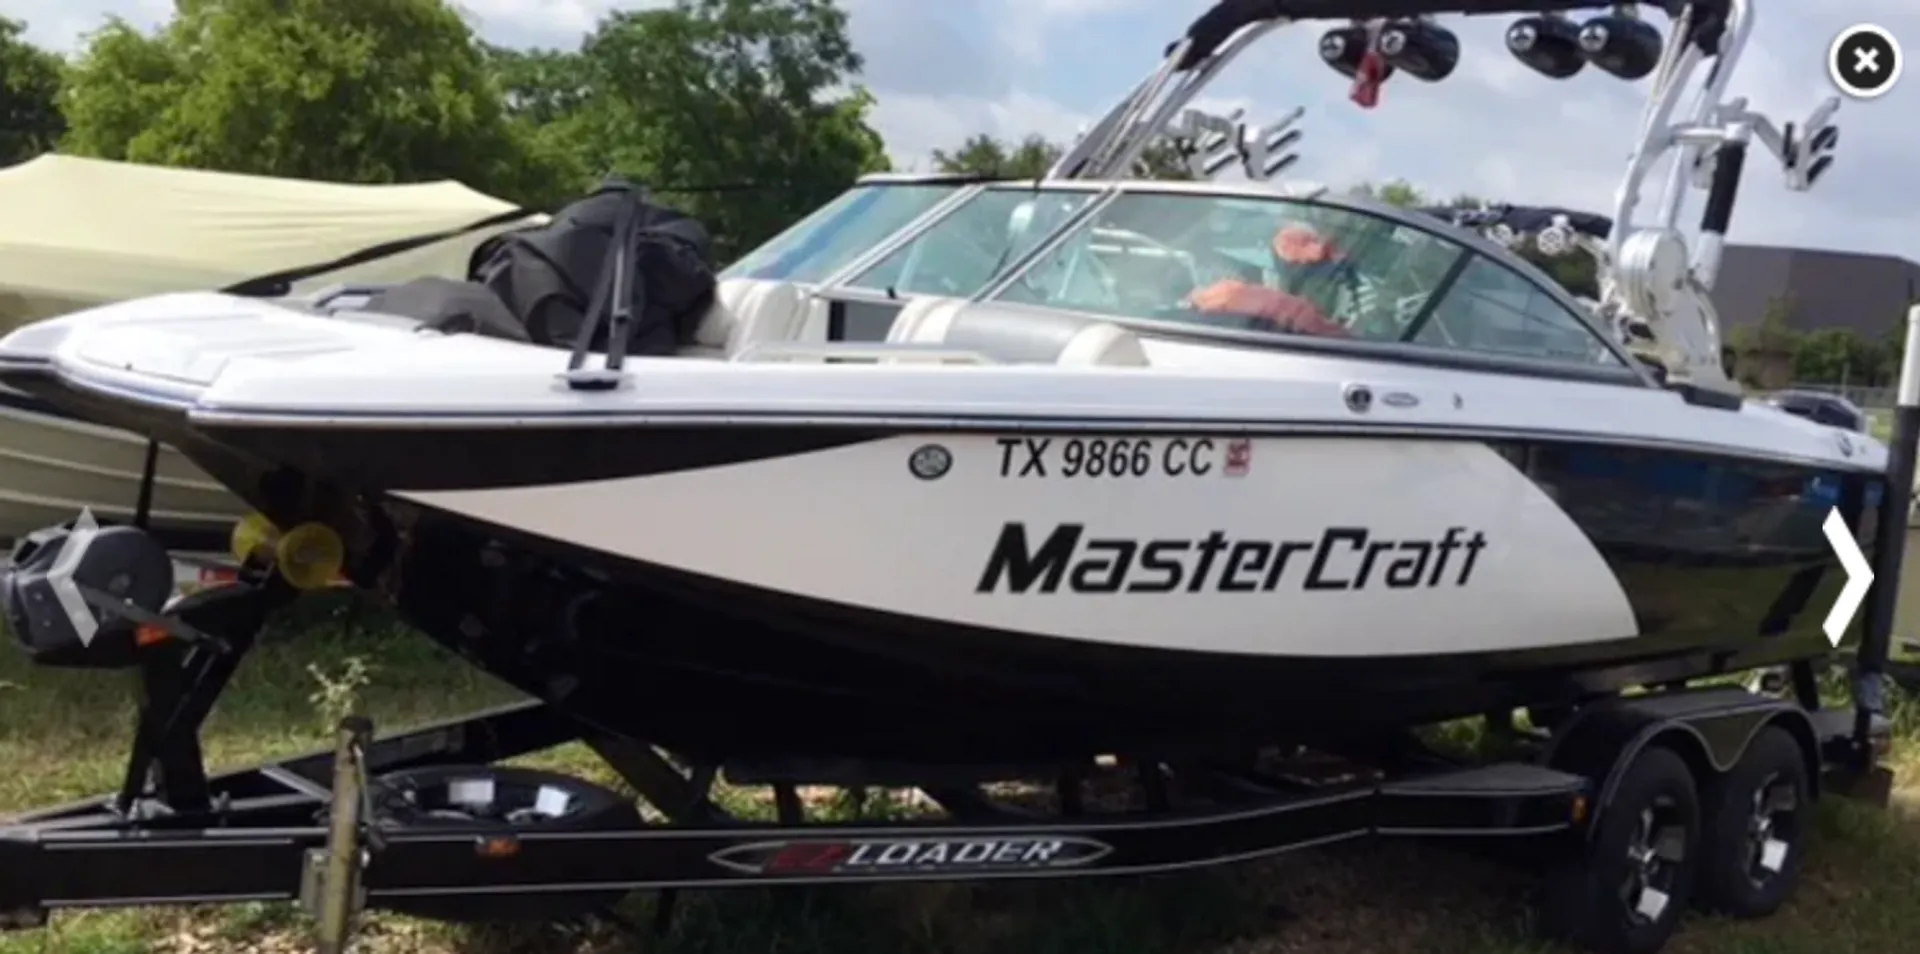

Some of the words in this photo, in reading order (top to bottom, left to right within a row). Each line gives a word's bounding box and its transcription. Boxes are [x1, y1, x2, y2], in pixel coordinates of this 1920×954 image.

[996, 438, 1051, 477] TX
[1062, 439, 1152, 478] 9866
[1162, 438, 1215, 477] CC
[975, 522, 1487, 594] MasterCraft
